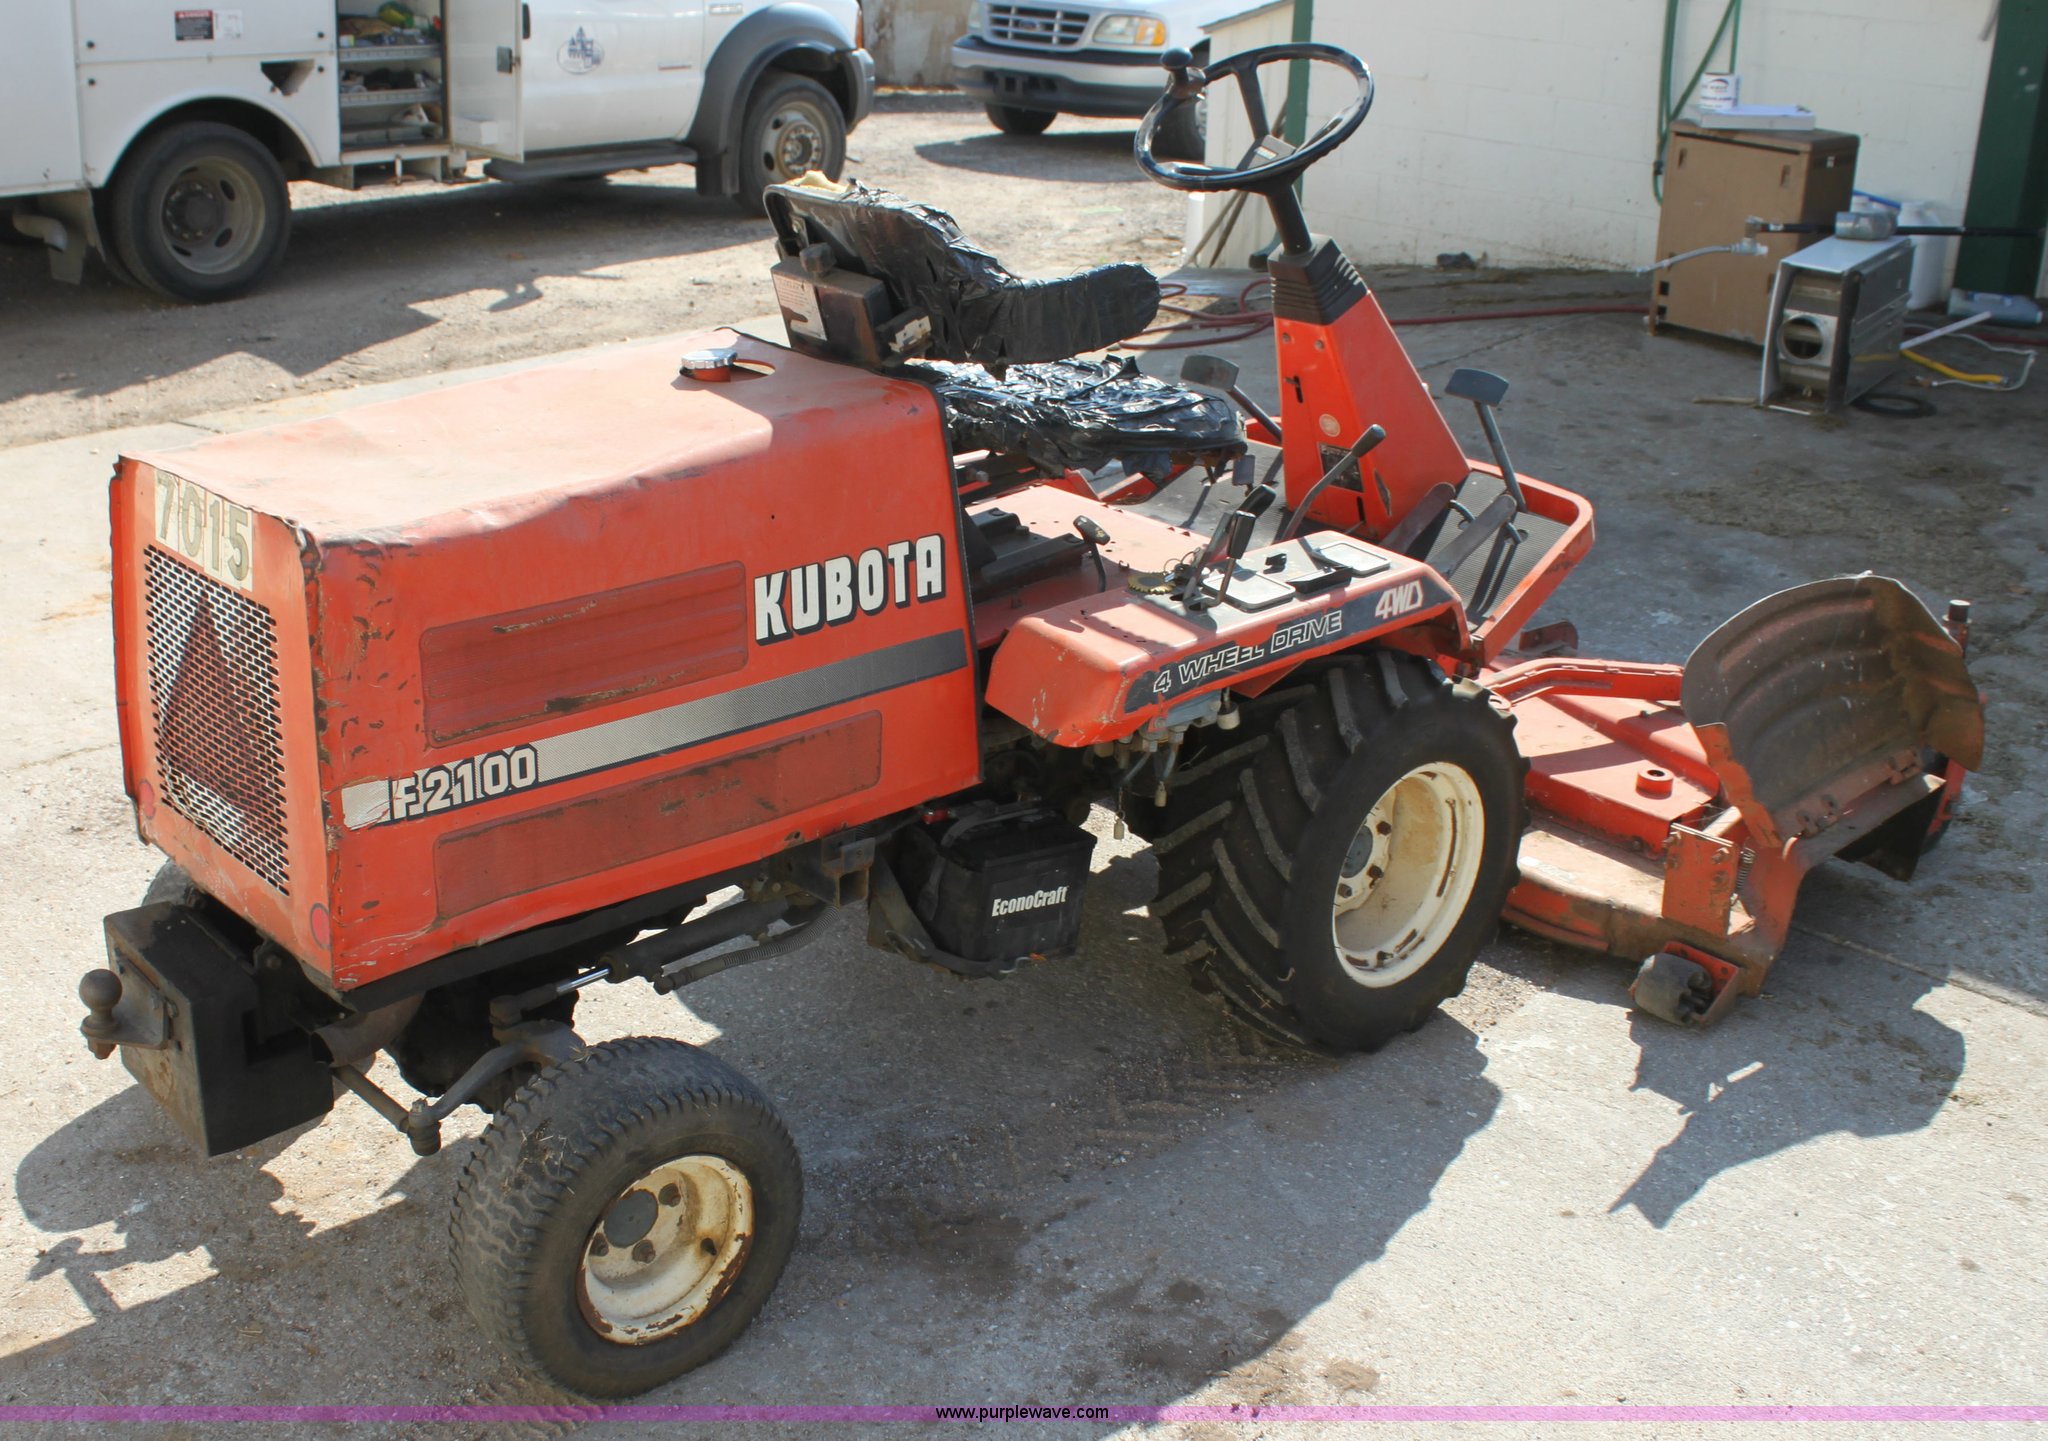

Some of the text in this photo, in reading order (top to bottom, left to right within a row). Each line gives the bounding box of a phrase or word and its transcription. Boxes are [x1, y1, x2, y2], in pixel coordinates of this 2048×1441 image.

[156, 469, 250, 582] 7015
[754, 533, 946, 647] KUBOTA
[1375, 580, 1423, 620] 4WD
[1153, 610, 1342, 693] 4 WHEEL DRIVE
[390, 746, 537, 820] F2100
[991, 886, 1068, 917] EconoCraft
